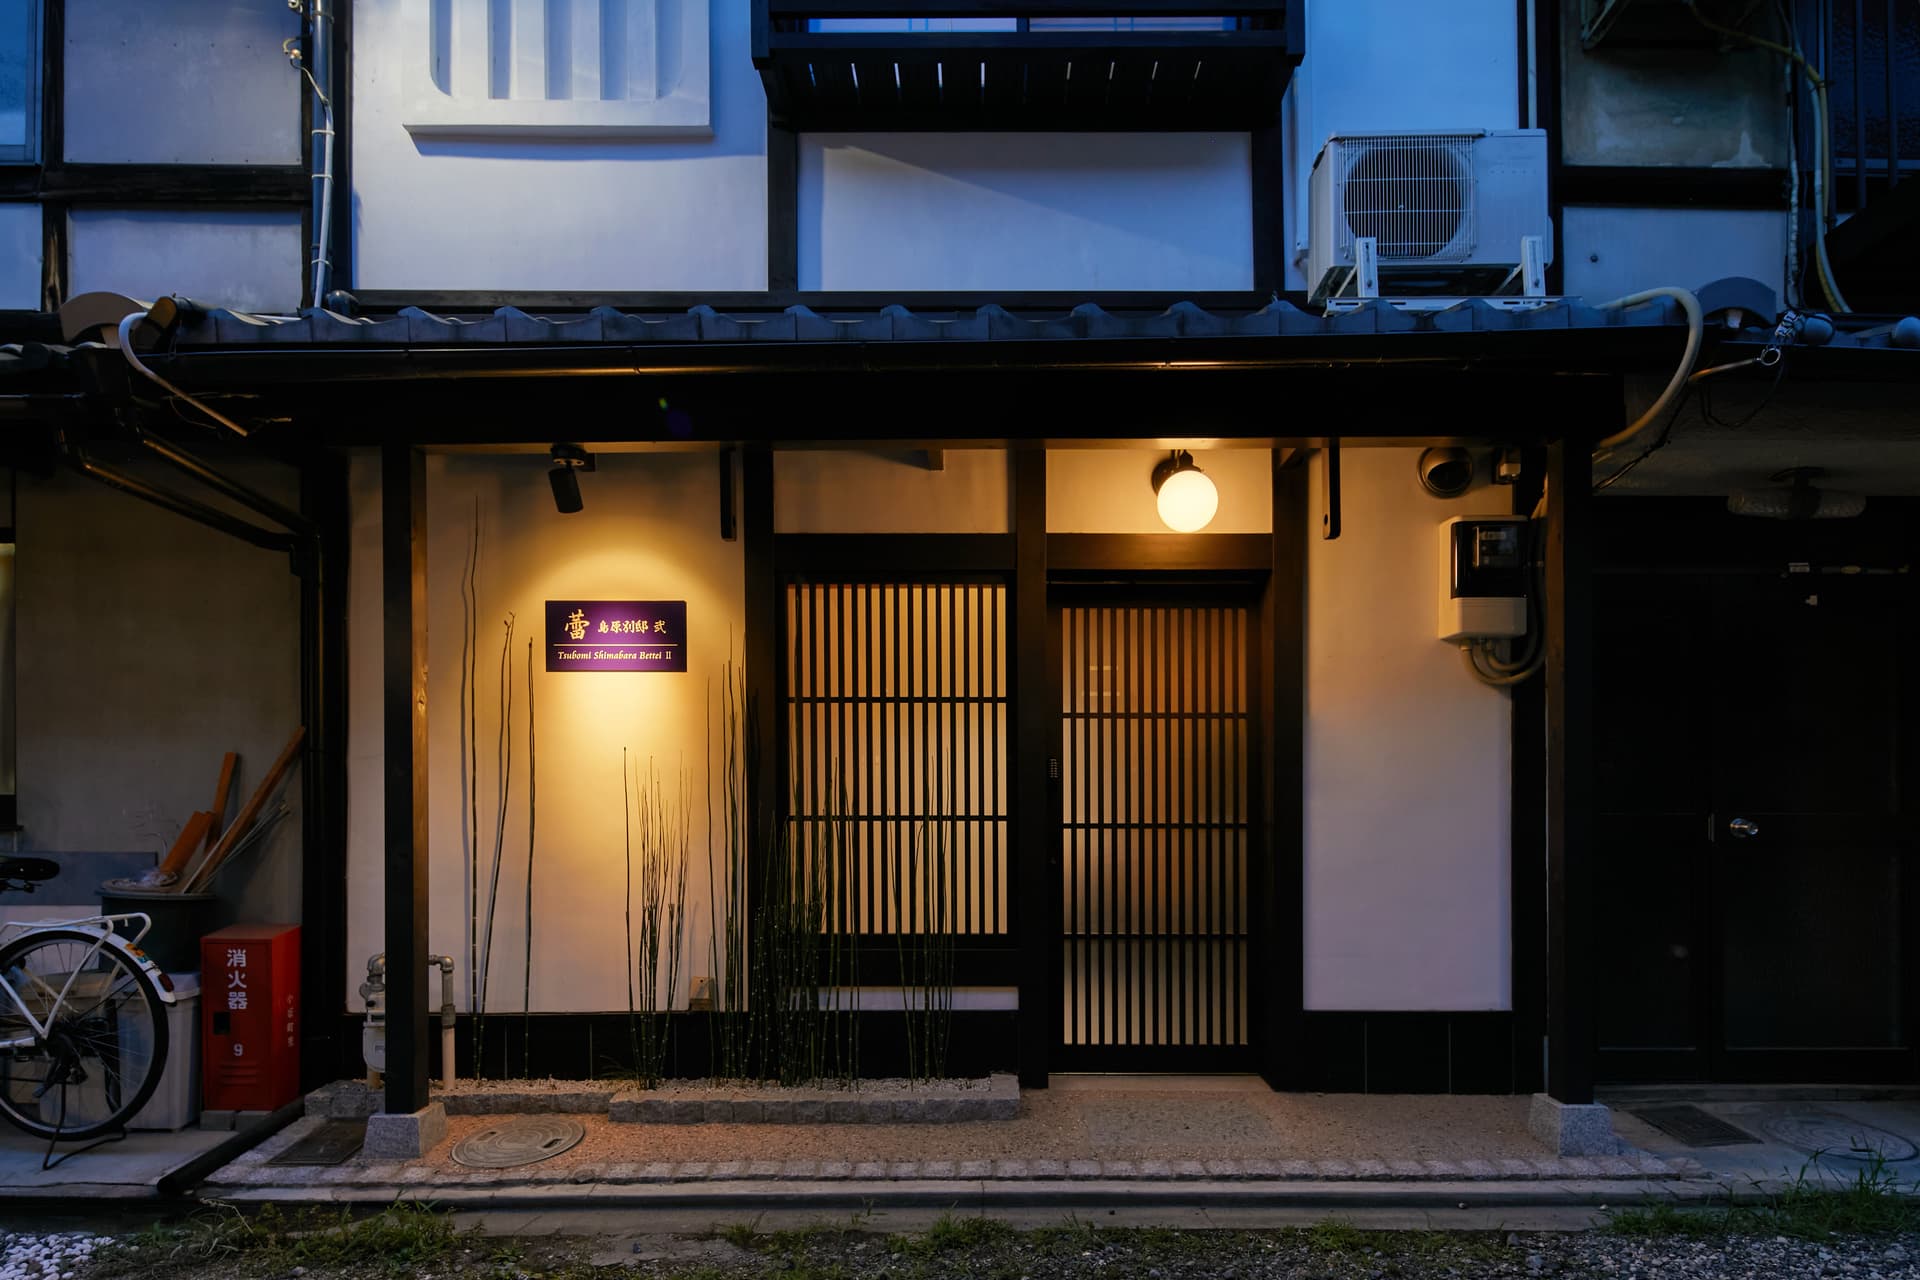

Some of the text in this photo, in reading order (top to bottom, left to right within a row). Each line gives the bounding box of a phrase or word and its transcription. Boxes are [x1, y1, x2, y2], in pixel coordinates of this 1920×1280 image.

[564, 608, 590, 640] 蕾
[597, 620, 649, 634] 島原別邸
[558, 650, 592, 660] Tsubomi
[593, 650, 637, 660] Shimabara
[639, 651, 662, 660] Bettei
[226, 948, 248, 1010] 消火器
[233, 1043, 244, 1056] 9
